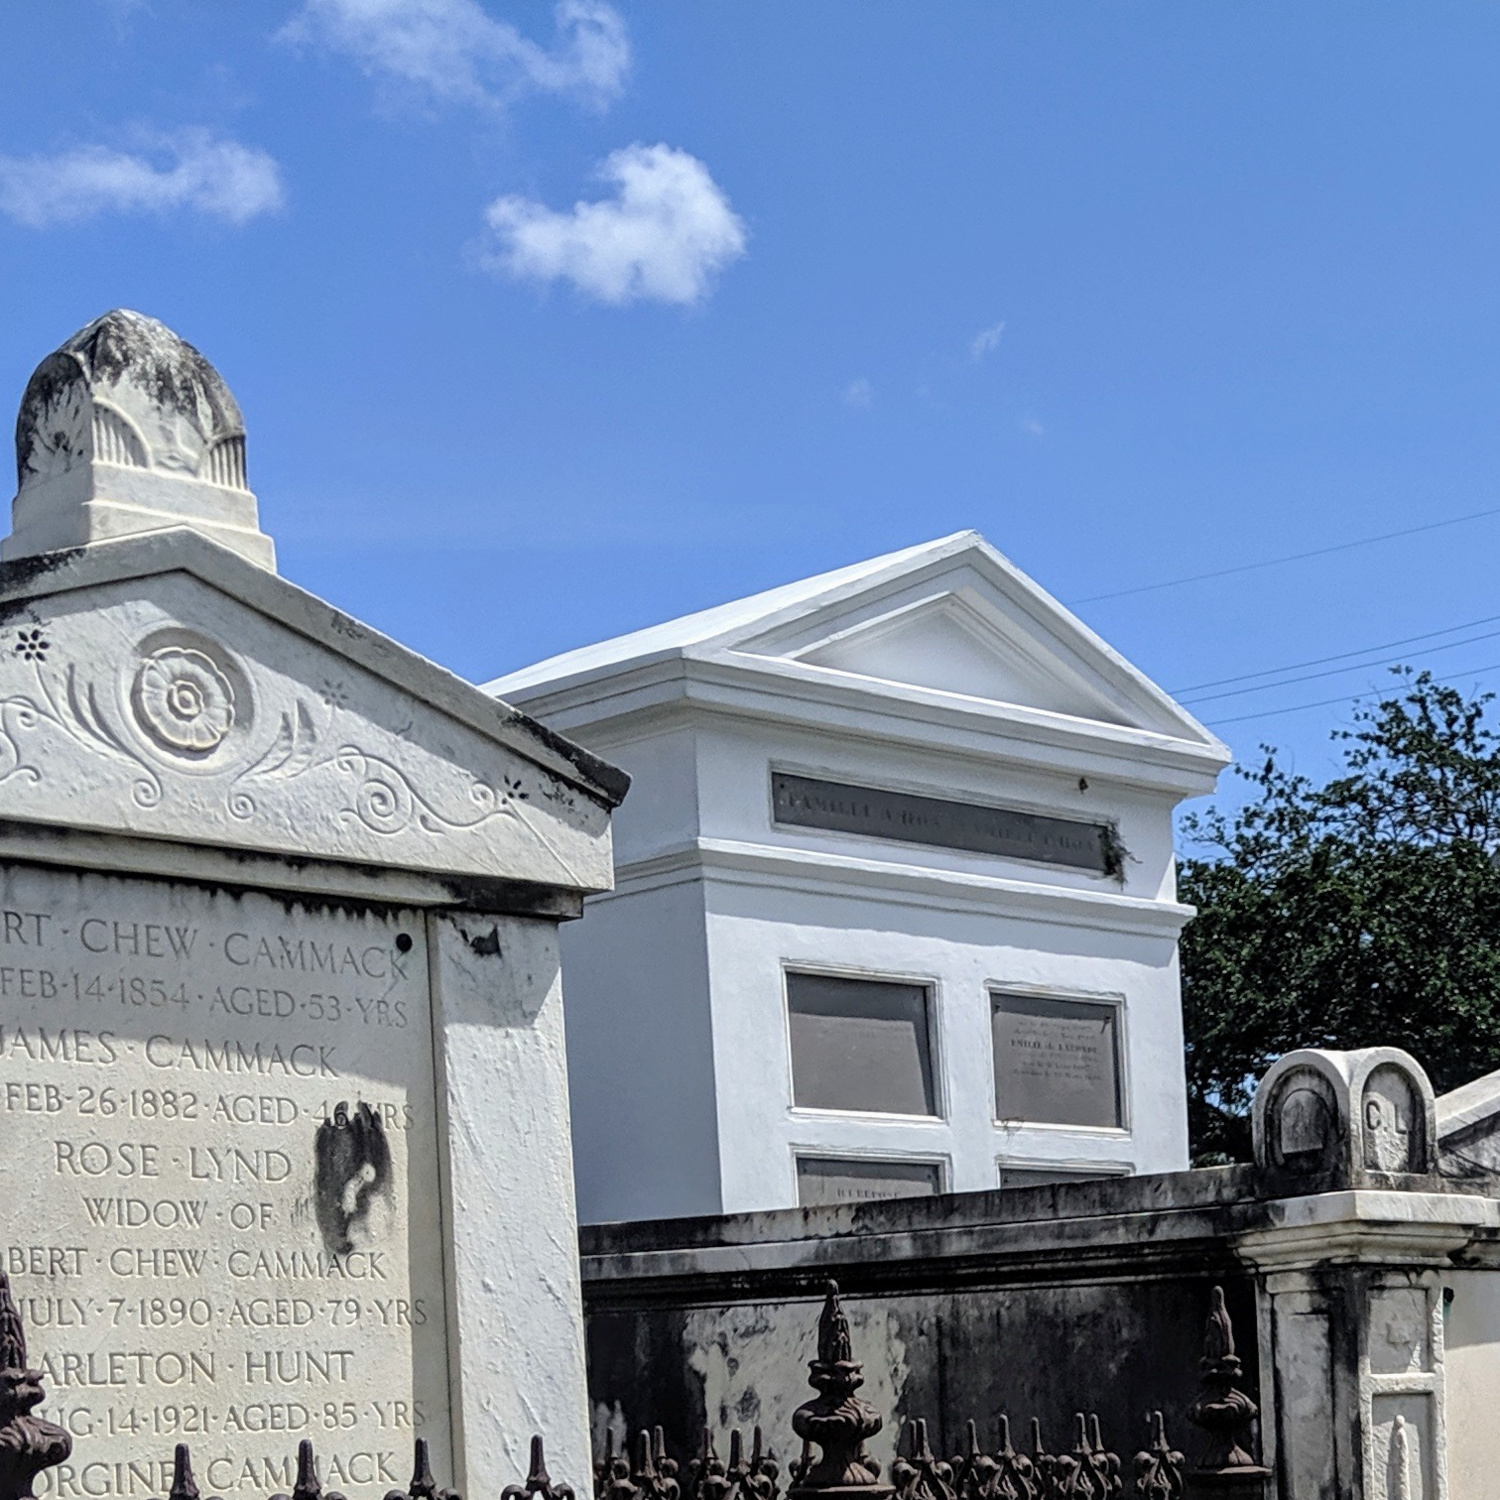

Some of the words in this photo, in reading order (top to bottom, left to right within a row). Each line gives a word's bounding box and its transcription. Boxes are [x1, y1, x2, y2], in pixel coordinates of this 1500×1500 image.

[80, 918, 199, 959] CHEW
[224, 932, 408, 980] CAMMACK
[0, 967, 57, 999] FEB
[73, 972, 105, 1001] 14
[119, 977, 190, 1012] 1854
[209, 985, 296, 1018] AGED
[308, 994, 341, 1022] 53
[356, 997, 409, 1029] YRS
[146, 1034, 339, 1078] CAMMACK
[6, 1082, 63, 1113] FEB
[78, 1086, 118, 1116] 26
[130, 1089, 199, 1119] 1882
[212, 1094, 299, 1125] AGED
[55, 1141, 160, 1177] ROSE
[190, 1146, 291, 1183] LYND
[82, 1198, 208, 1229] WIDOW
[230, 1202, 273, 1230] OF
[109, 1247, 208, 1278] CHEW
[227, 1250, 388, 1280] CAMMACK
[108, 1298, 126, 1327] 7
[139, 1297, 212, 1327] 1890
[227, 1299, 315, 1327] AGED
[327, 1299, 361, 1326] 79
[374, 1298, 428, 1327] YRS
[245, 1351, 354, 1383] HUNT
[108, 1405, 140, 1436] 14
[152, 1403, 209, 1435] 1921
[223, 1402, 309, 1432] AGED
[322, 1401, 358, 1429] 85
[371, 1400, 426, 1430] YRS
